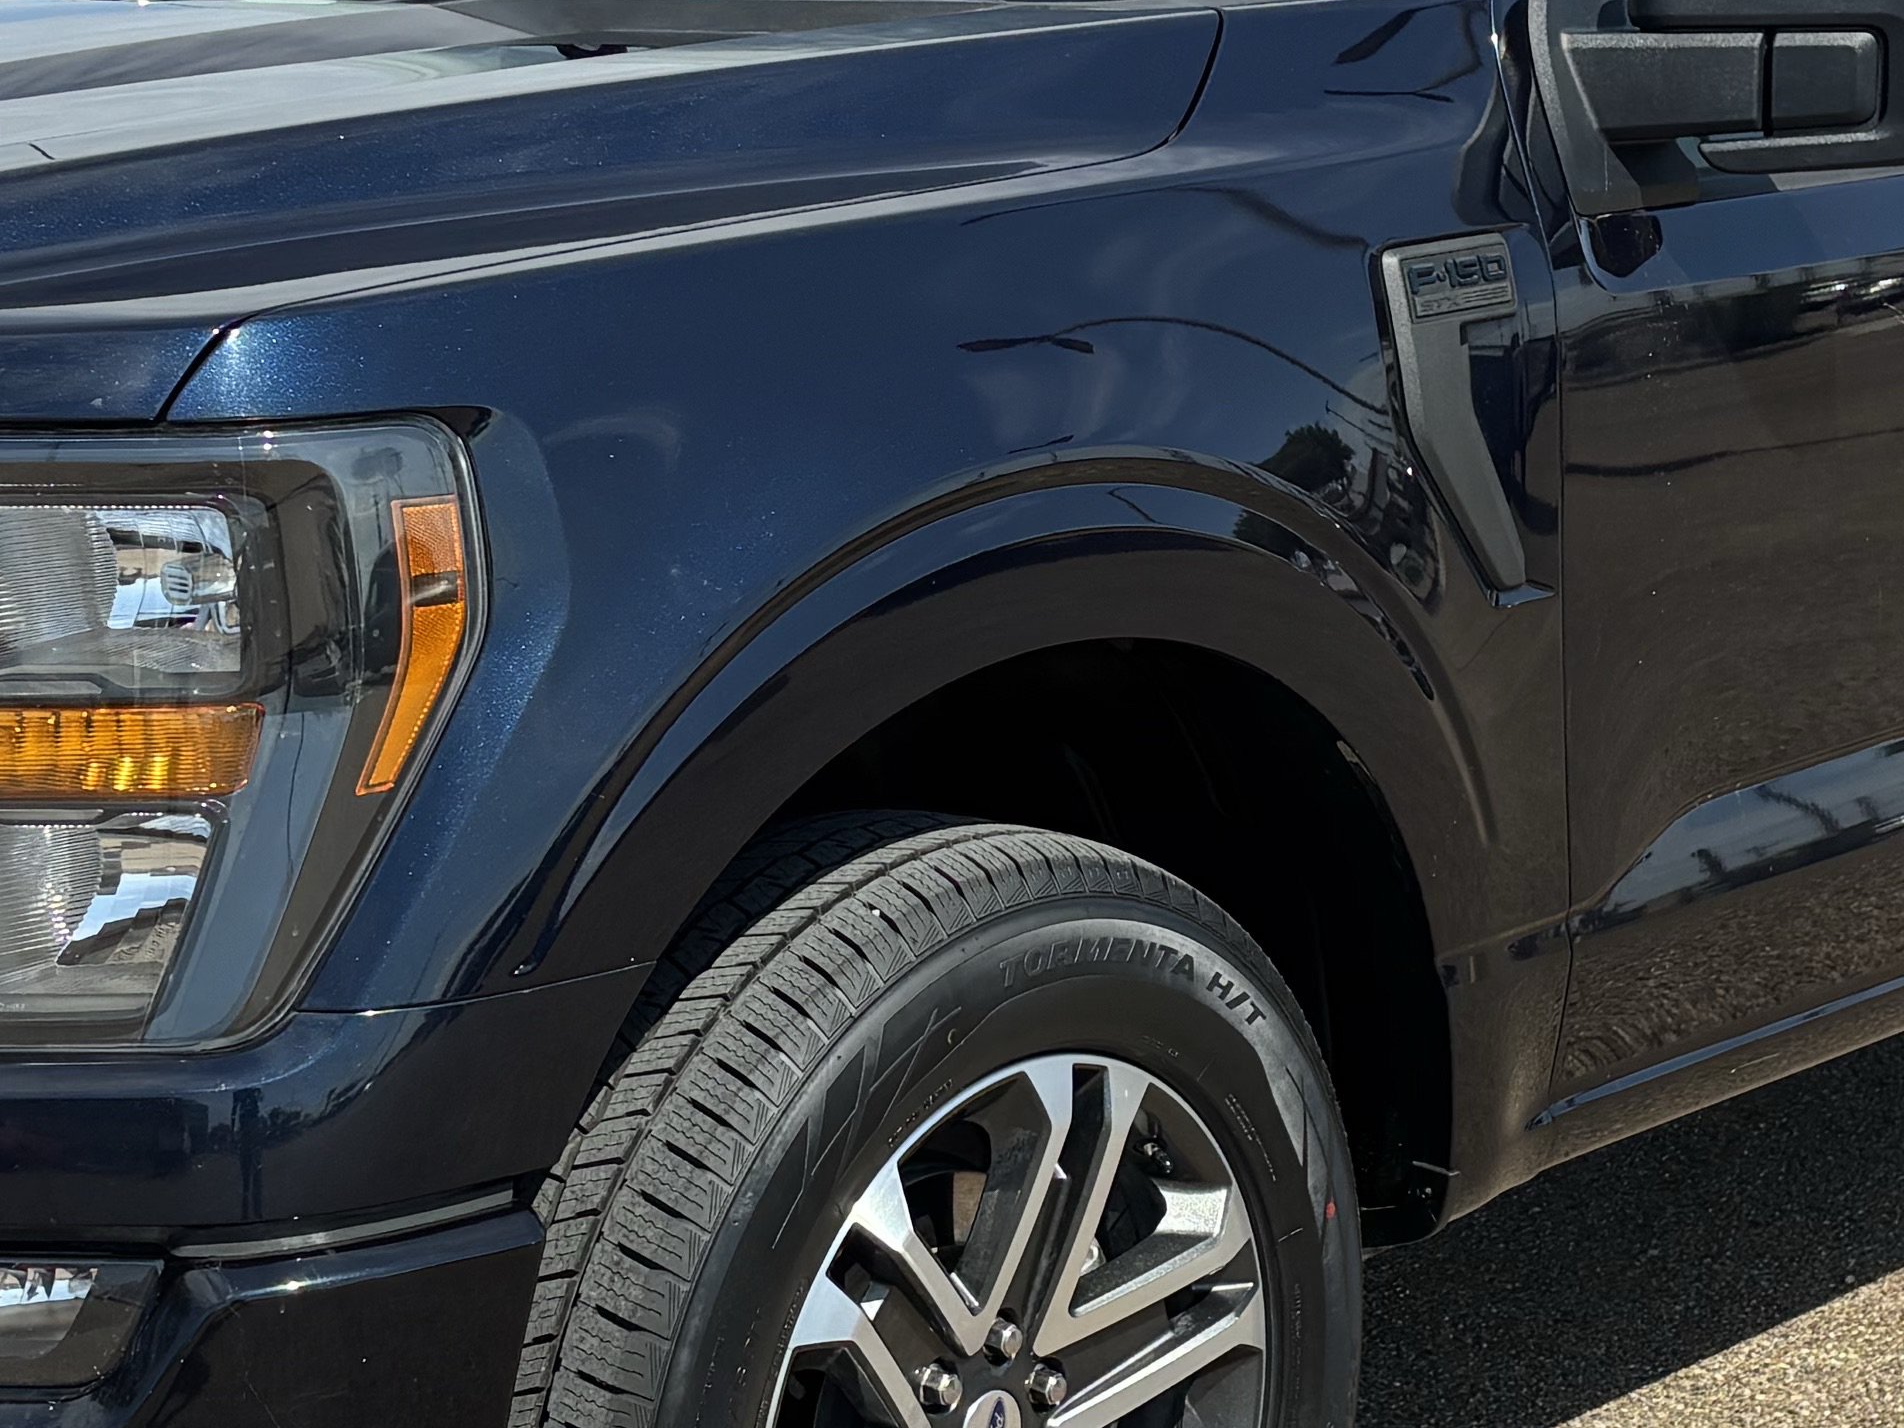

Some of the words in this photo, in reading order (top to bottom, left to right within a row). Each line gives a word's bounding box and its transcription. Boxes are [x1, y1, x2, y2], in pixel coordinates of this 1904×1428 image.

[1408, 254, 1508, 294] F-150
[999, 935, 1197, 989] TORMENTA
[1205, 971, 1267, 1026] H/T
